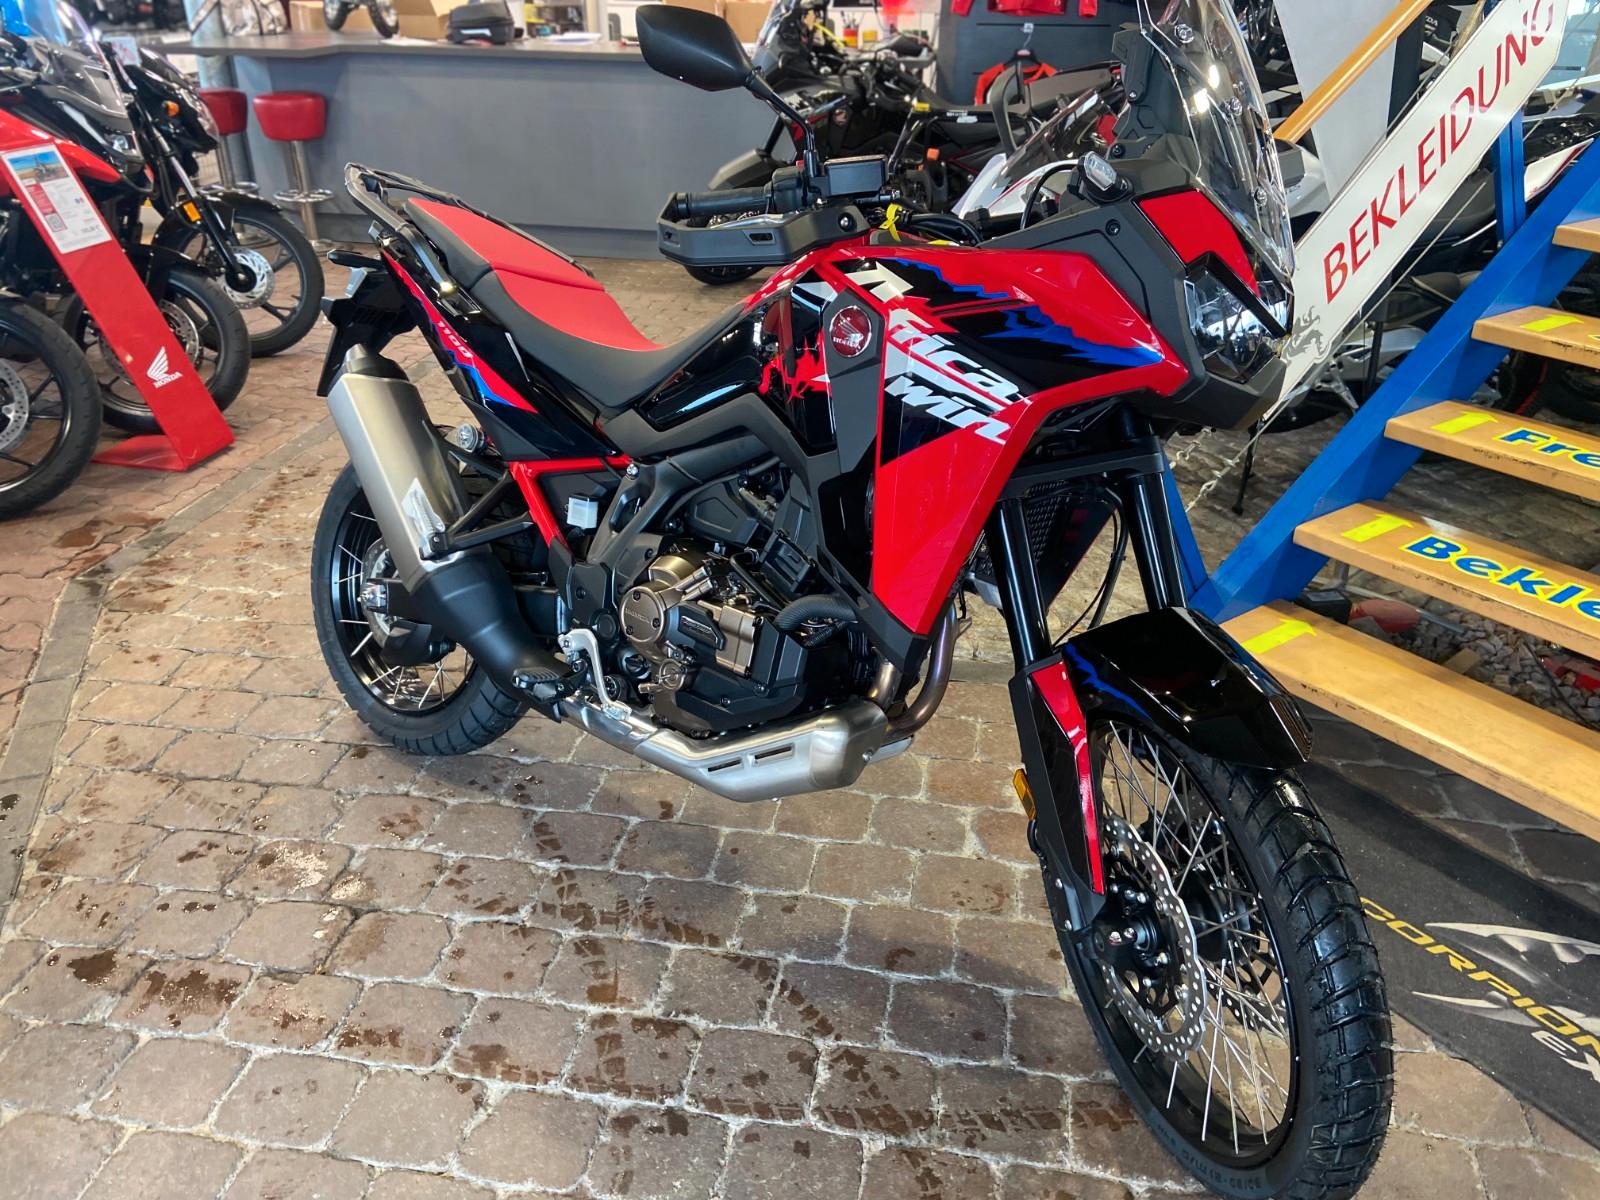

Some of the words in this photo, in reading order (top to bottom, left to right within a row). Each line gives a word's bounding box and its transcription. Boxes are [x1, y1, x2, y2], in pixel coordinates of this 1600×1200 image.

[1323, 0, 1553, 304] BEKLEIDUNG
[153, 371, 183, 389] HONDA
[1360, 896, 1600, 1058] CORPION
